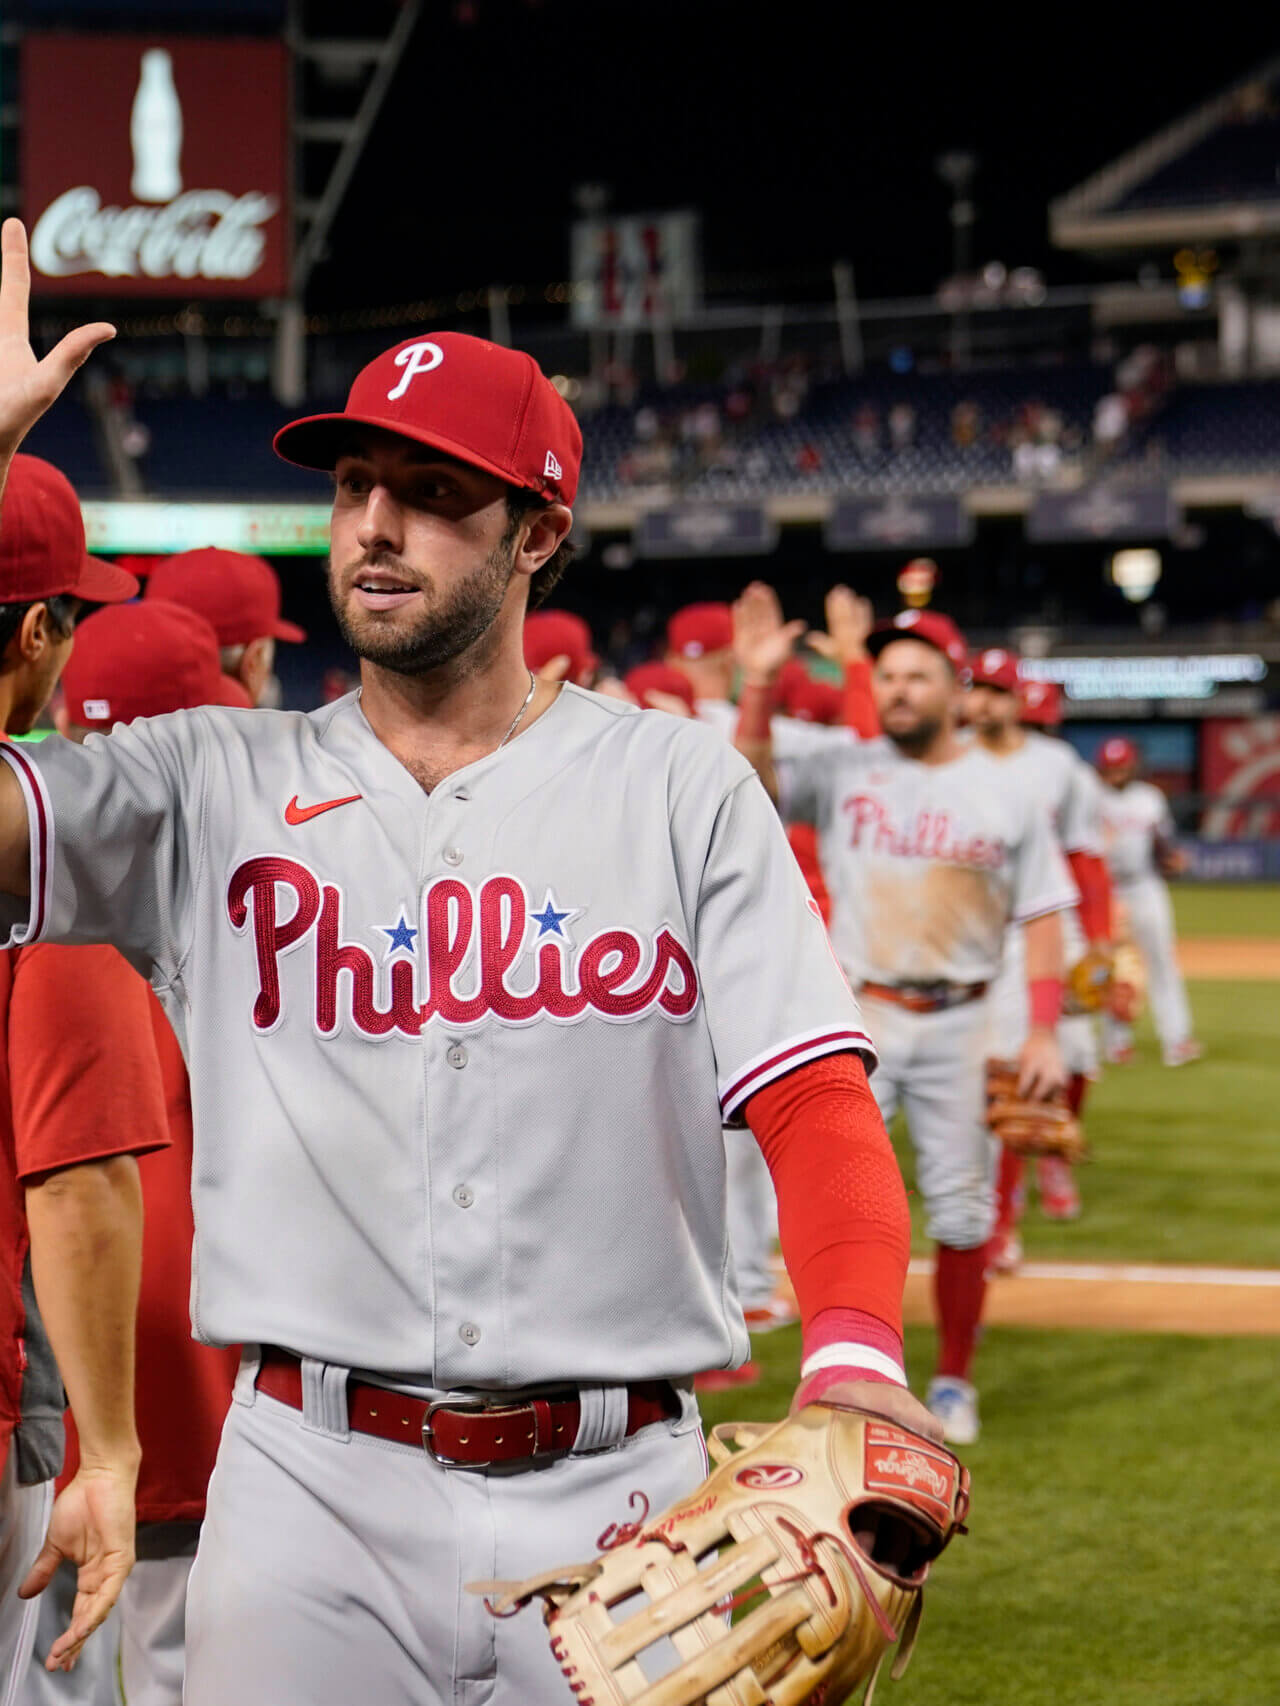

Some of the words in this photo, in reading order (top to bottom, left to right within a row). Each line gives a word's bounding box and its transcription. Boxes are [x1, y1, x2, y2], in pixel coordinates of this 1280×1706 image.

[387, 342, 444, 401] P
[841, 793, 1007, 868] Phillies
[226, 853, 702, 1040] Phillies
